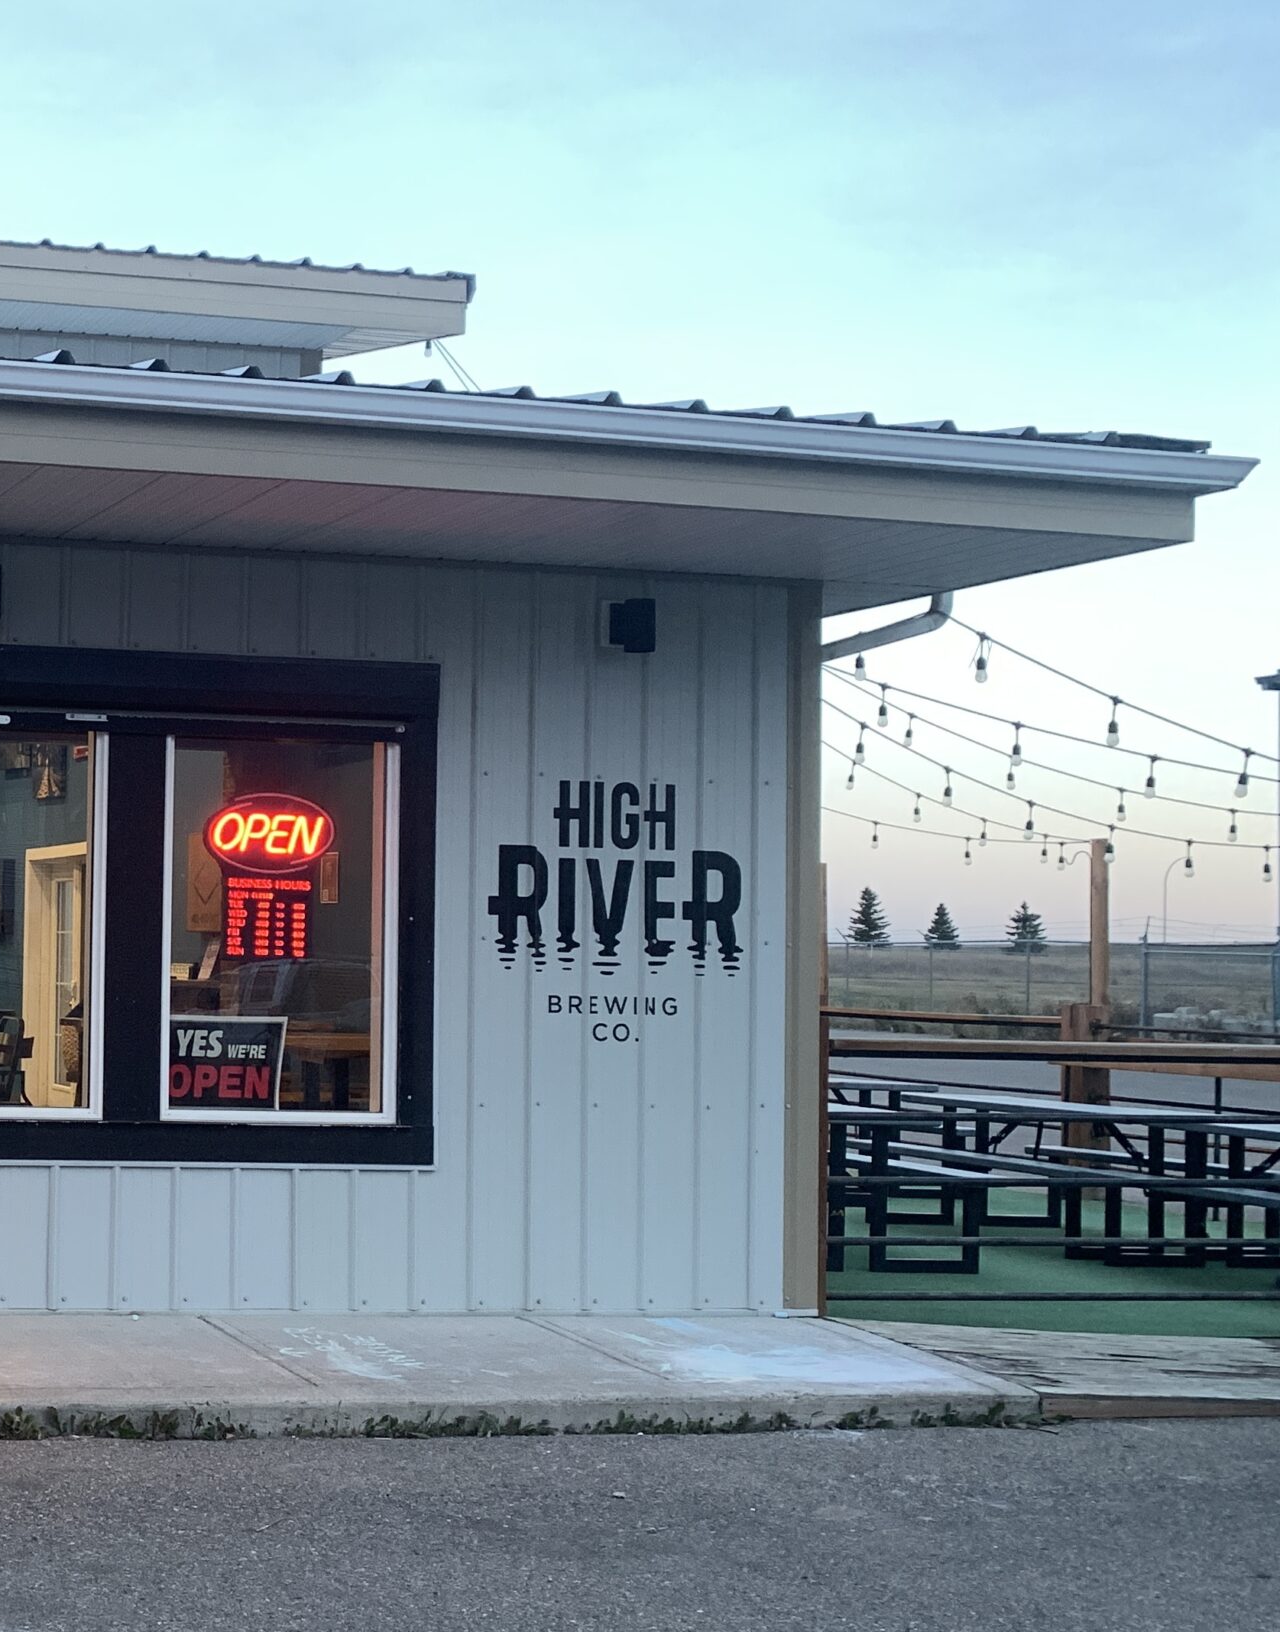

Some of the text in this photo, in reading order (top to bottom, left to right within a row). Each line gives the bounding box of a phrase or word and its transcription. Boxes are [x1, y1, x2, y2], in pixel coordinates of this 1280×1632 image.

[553, 780, 676, 851] HIGH
[213, 812, 325, 855] OPEN
[227, 877, 312, 891] BUSINESS HOURS
[488, 844, 744, 962] RIVER
[548, 995, 679, 1016] BREWING
[176, 1029, 267, 1060] YES WE'RE
[592, 1023, 640, 1043] CO.
[169, 1064, 271, 1099] OPEN
